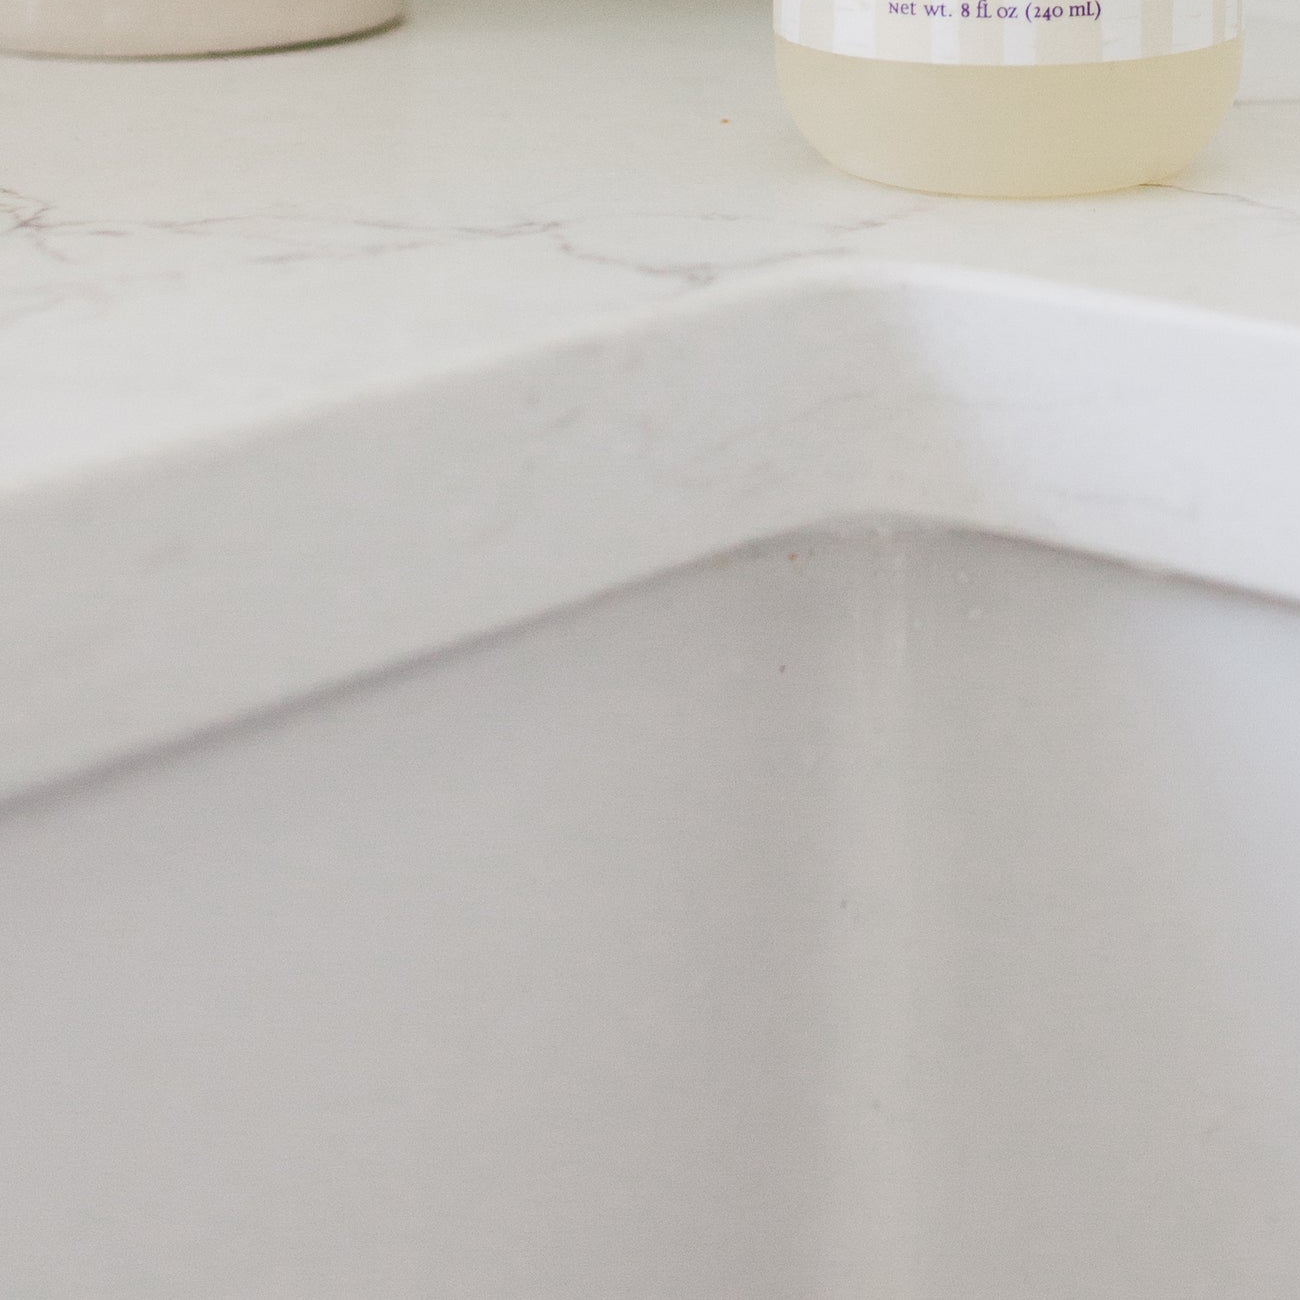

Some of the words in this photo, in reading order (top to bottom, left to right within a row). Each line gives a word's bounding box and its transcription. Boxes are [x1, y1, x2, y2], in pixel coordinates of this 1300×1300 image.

[888, 2, 917, 17] Net
[923, 3, 952, 18] wt.
[960, 3, 971, 18] 8
[996, 6, 1018, 19] oz
[1025, 3, 1064, 23] (240
